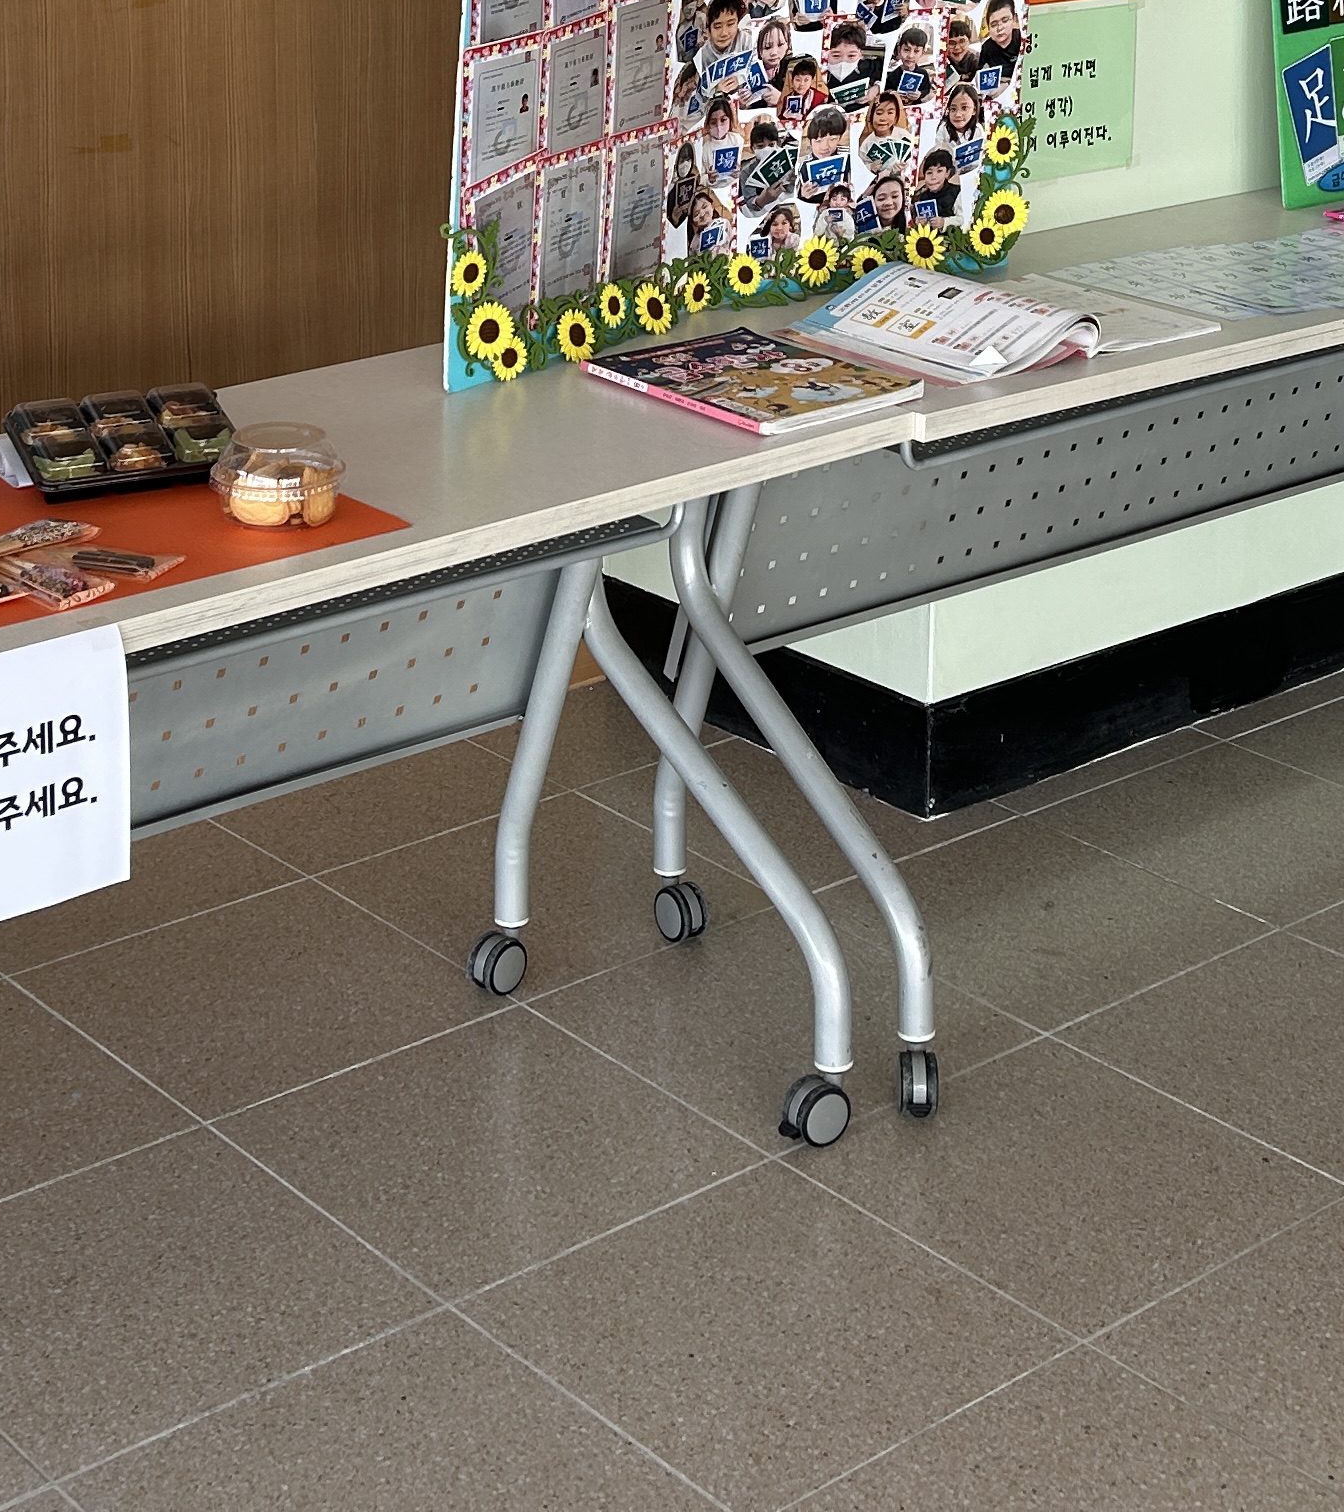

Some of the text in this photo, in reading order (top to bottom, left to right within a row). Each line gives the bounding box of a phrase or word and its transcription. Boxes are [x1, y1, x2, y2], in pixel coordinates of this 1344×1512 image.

[1061, 59, 1097, 78] 가지면
[1045, 96, 1073, 119] 생각)
[1298, 67, 1337, 143] 足
[717, 150, 738, 169] 場
